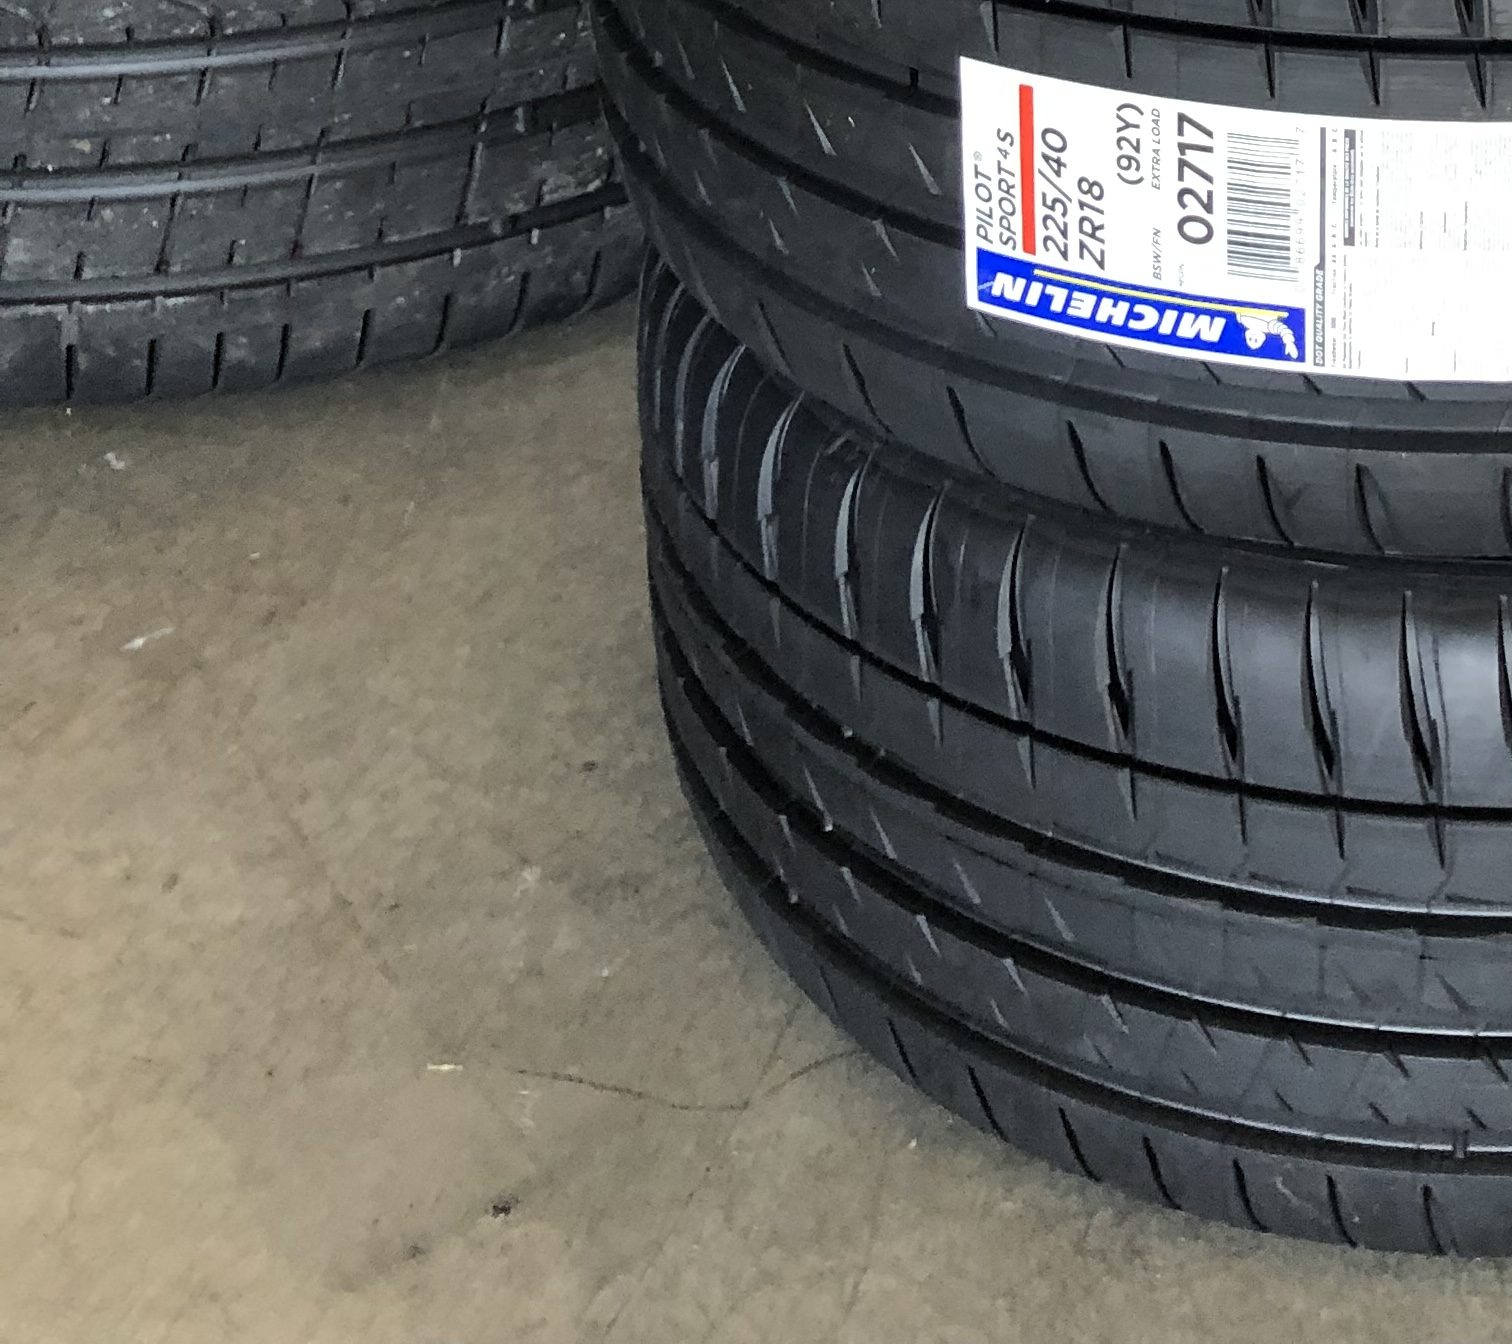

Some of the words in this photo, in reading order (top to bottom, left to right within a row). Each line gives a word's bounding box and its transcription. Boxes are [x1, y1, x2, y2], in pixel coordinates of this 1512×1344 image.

[1116, 103, 1144, 185] (92Y)
[1150, 108, 1161, 144] LOAD
[973, 163, 994, 244] PILOT
[1037, 127, 1072, 262] 225/40
[1151, 146, 1161, 190] EXTRA
[1176, 112, 1215, 245] 02717
[997, 160, 1016, 251] SPORT
[1077, 176, 1105, 270] ZR18
[1152, 228, 1162, 281] BSW/FN
[1315, 269, 1324, 301] GRADE
[991, 271, 1227, 342] MICHELIN
[1315, 303, 1324, 344] QUALITY
[1315, 345, 1324, 365] DOT
